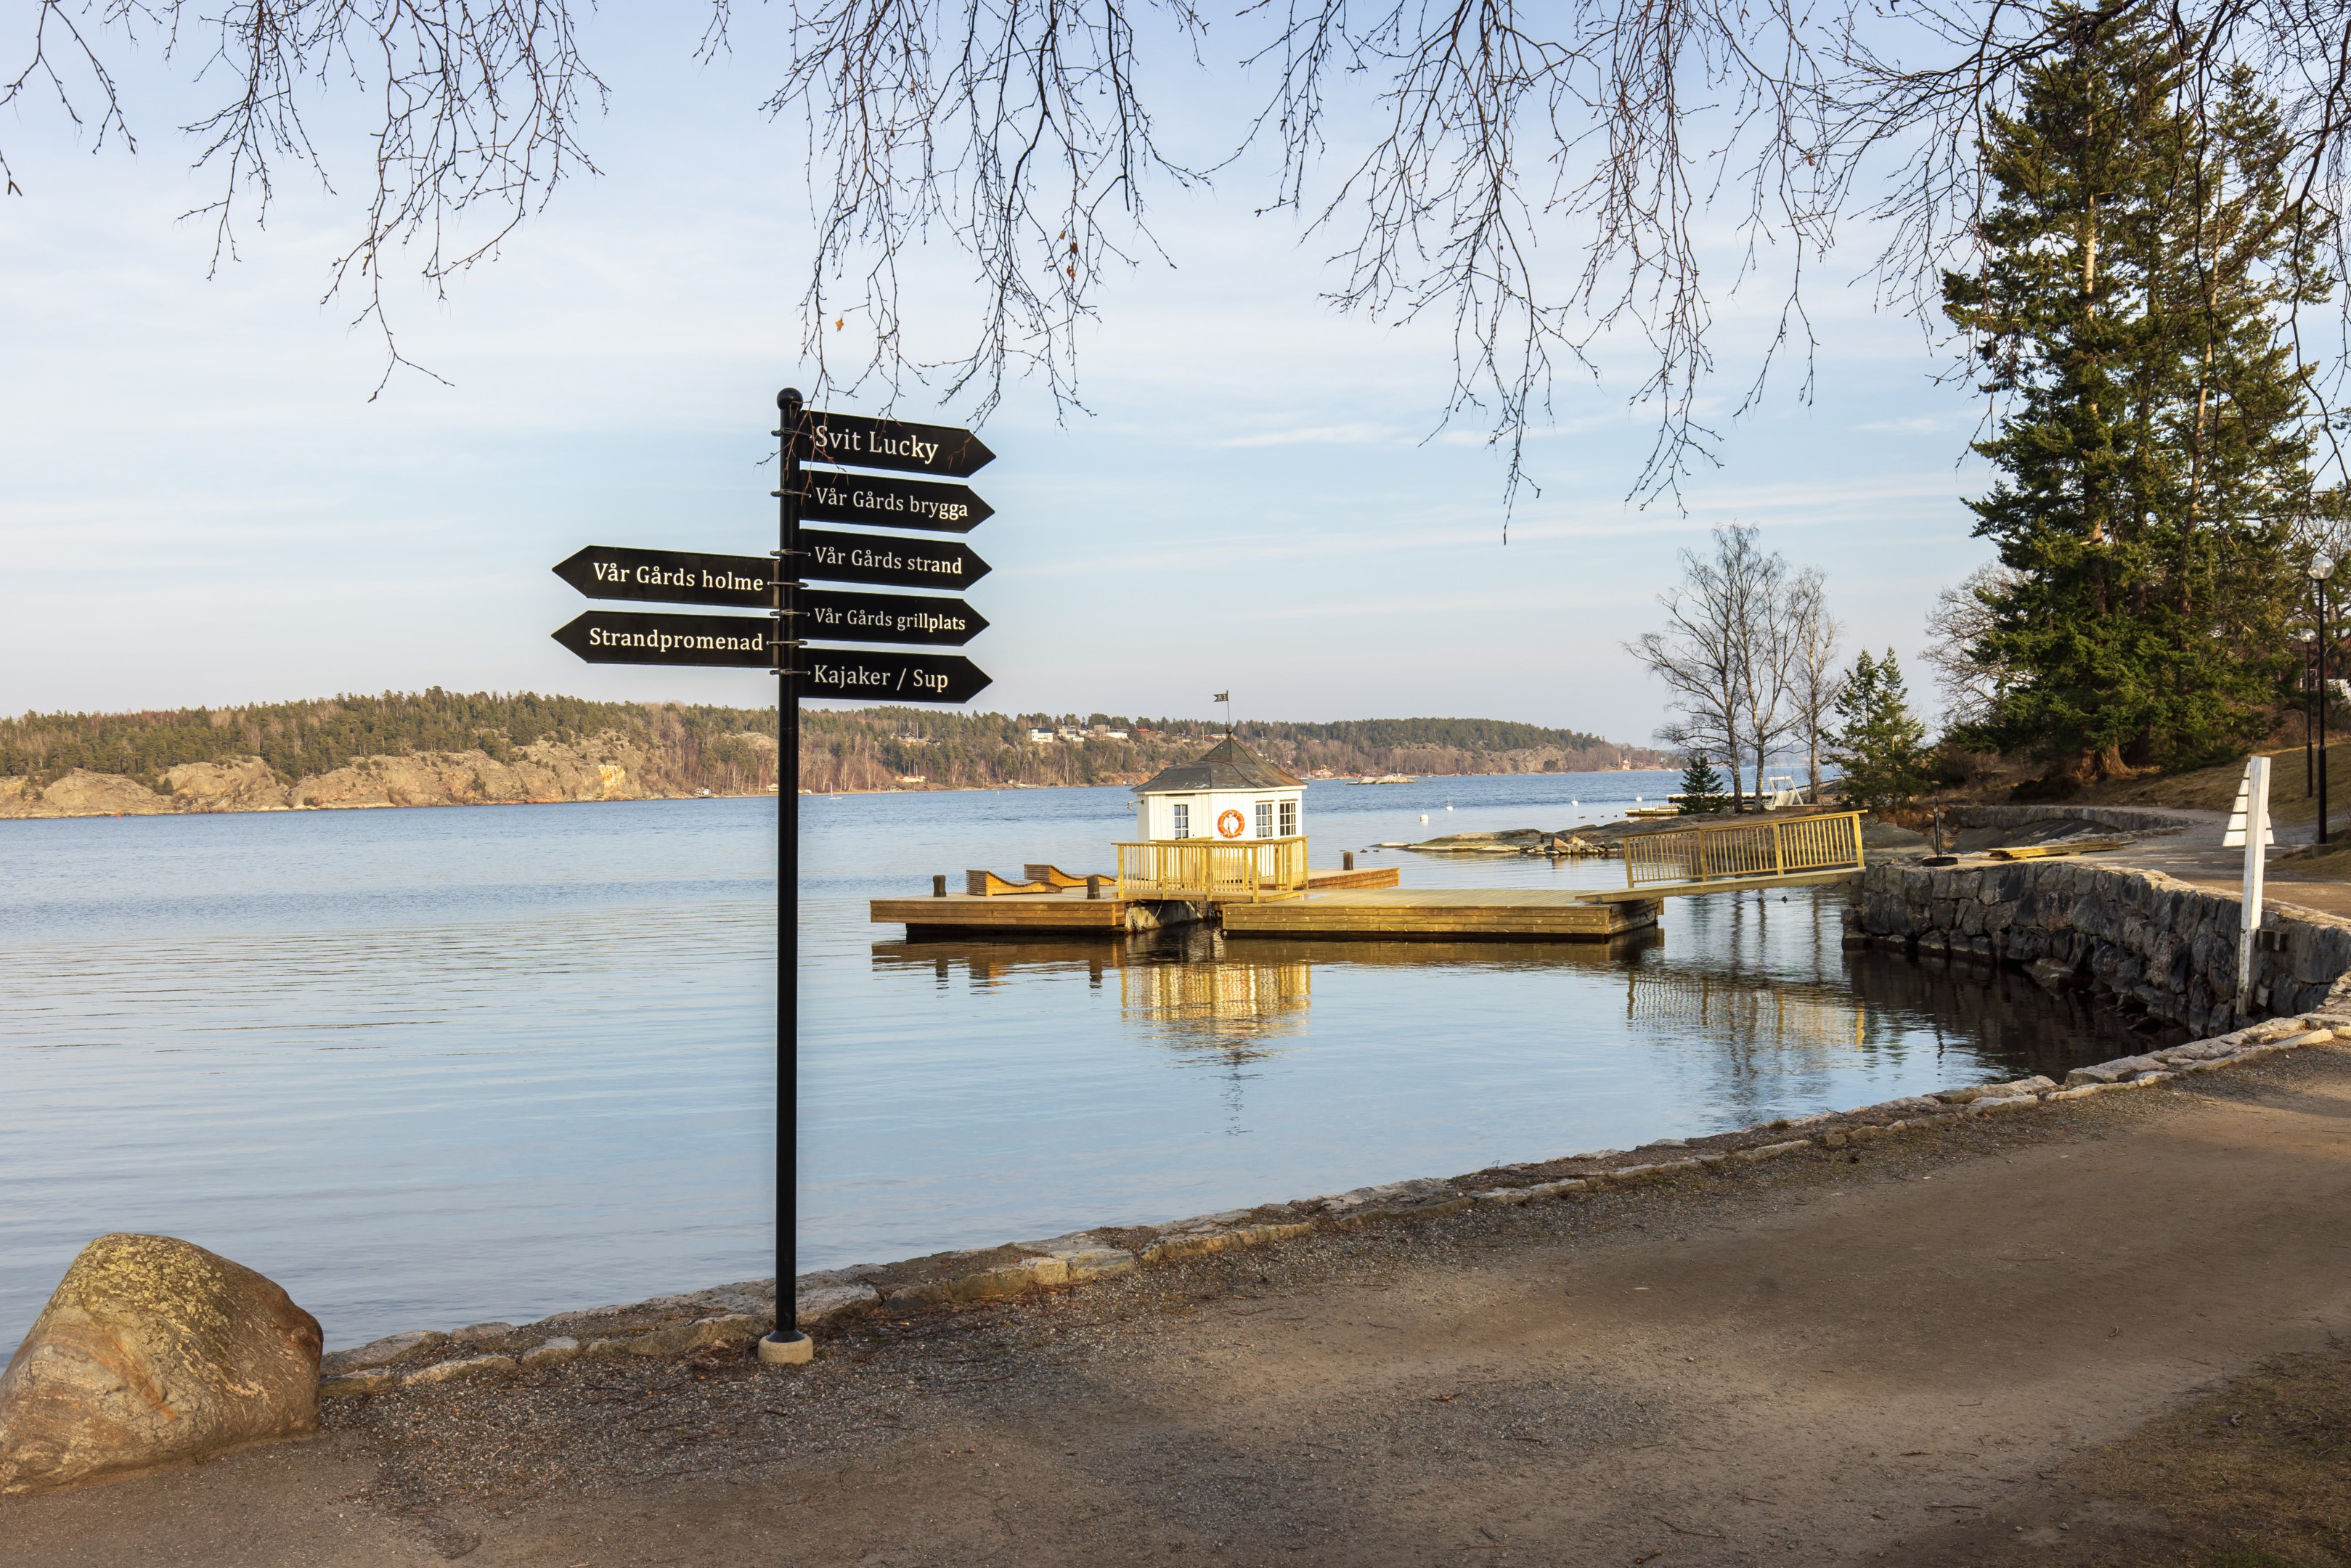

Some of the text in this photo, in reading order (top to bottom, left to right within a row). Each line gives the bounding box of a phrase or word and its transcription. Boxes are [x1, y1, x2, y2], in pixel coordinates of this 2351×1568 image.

[815, 425, 940, 465] Svit Lucky
[815, 487, 969, 520] Vår Gårds brygga
[814, 546, 963, 574] Vår Gårds strand
[592, 562, 764, 592] Vår Gårds holme
[814, 608, 966, 633] Vår Gårds grillplats
[590, 627, 763, 653] Strandpromenad
[814, 664, 948, 693] Kajaker / Sup
